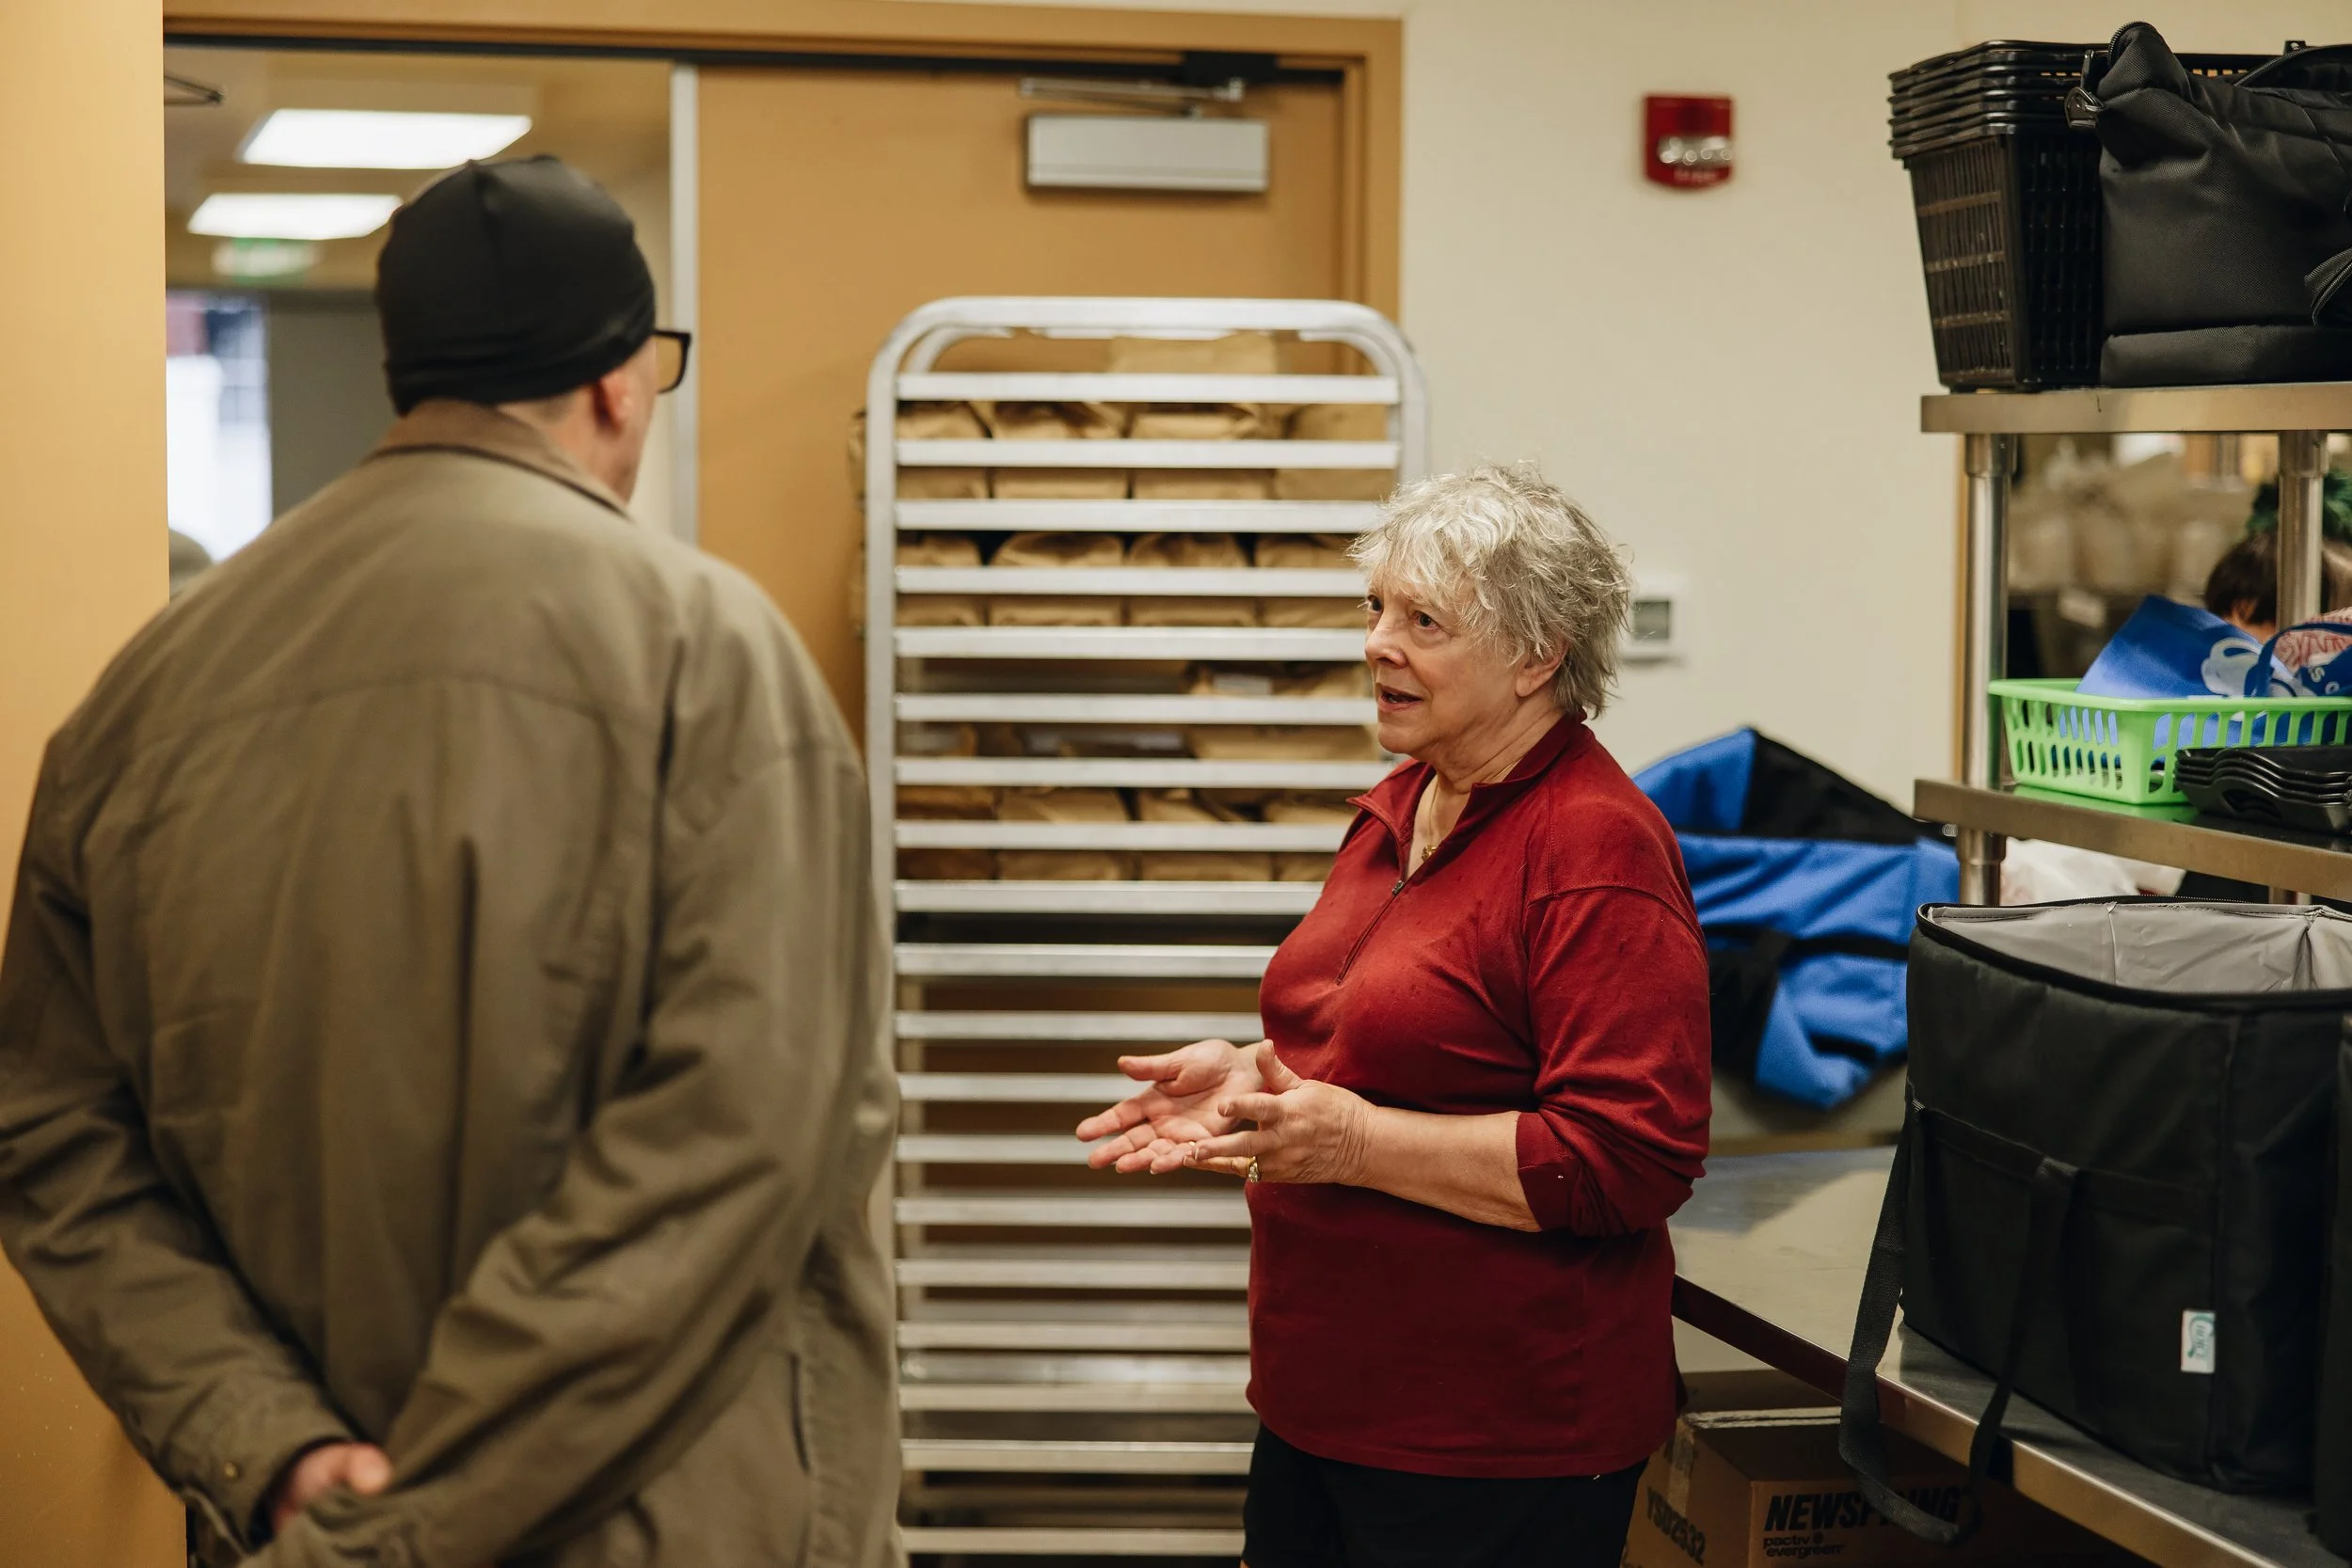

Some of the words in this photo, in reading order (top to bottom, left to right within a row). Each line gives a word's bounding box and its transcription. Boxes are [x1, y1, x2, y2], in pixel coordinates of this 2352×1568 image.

[1763, 1485, 1962, 1531] NEWSPNG
[1763, 1534, 1810, 1549] pactiv
[1766, 1544, 1842, 1560] evergreen
